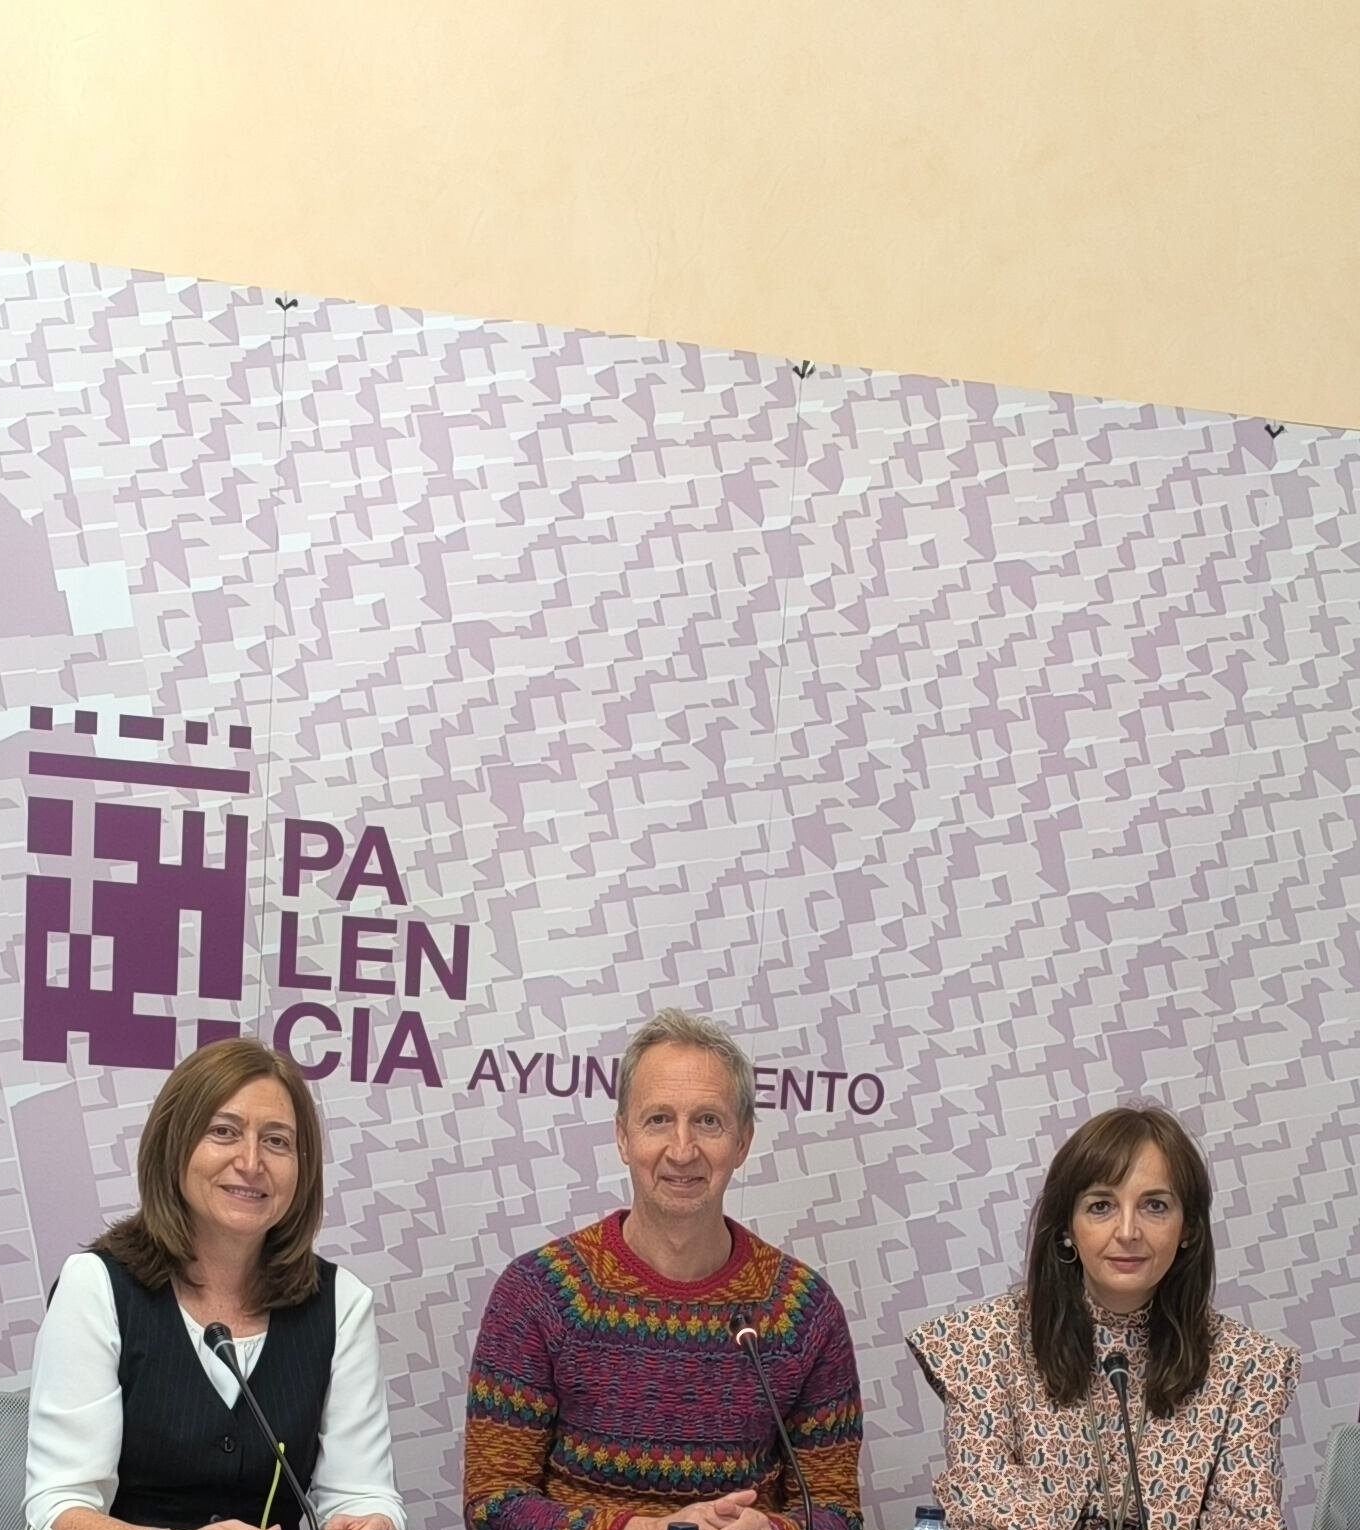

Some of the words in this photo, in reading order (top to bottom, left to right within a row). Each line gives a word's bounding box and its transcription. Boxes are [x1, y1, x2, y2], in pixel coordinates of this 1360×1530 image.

[282, 817, 408, 906] PA
[278, 910, 470, 1001] LEN
[273, 1001, 444, 1088] CIA
[467, 1048, 886, 1116] AYUNENTO
